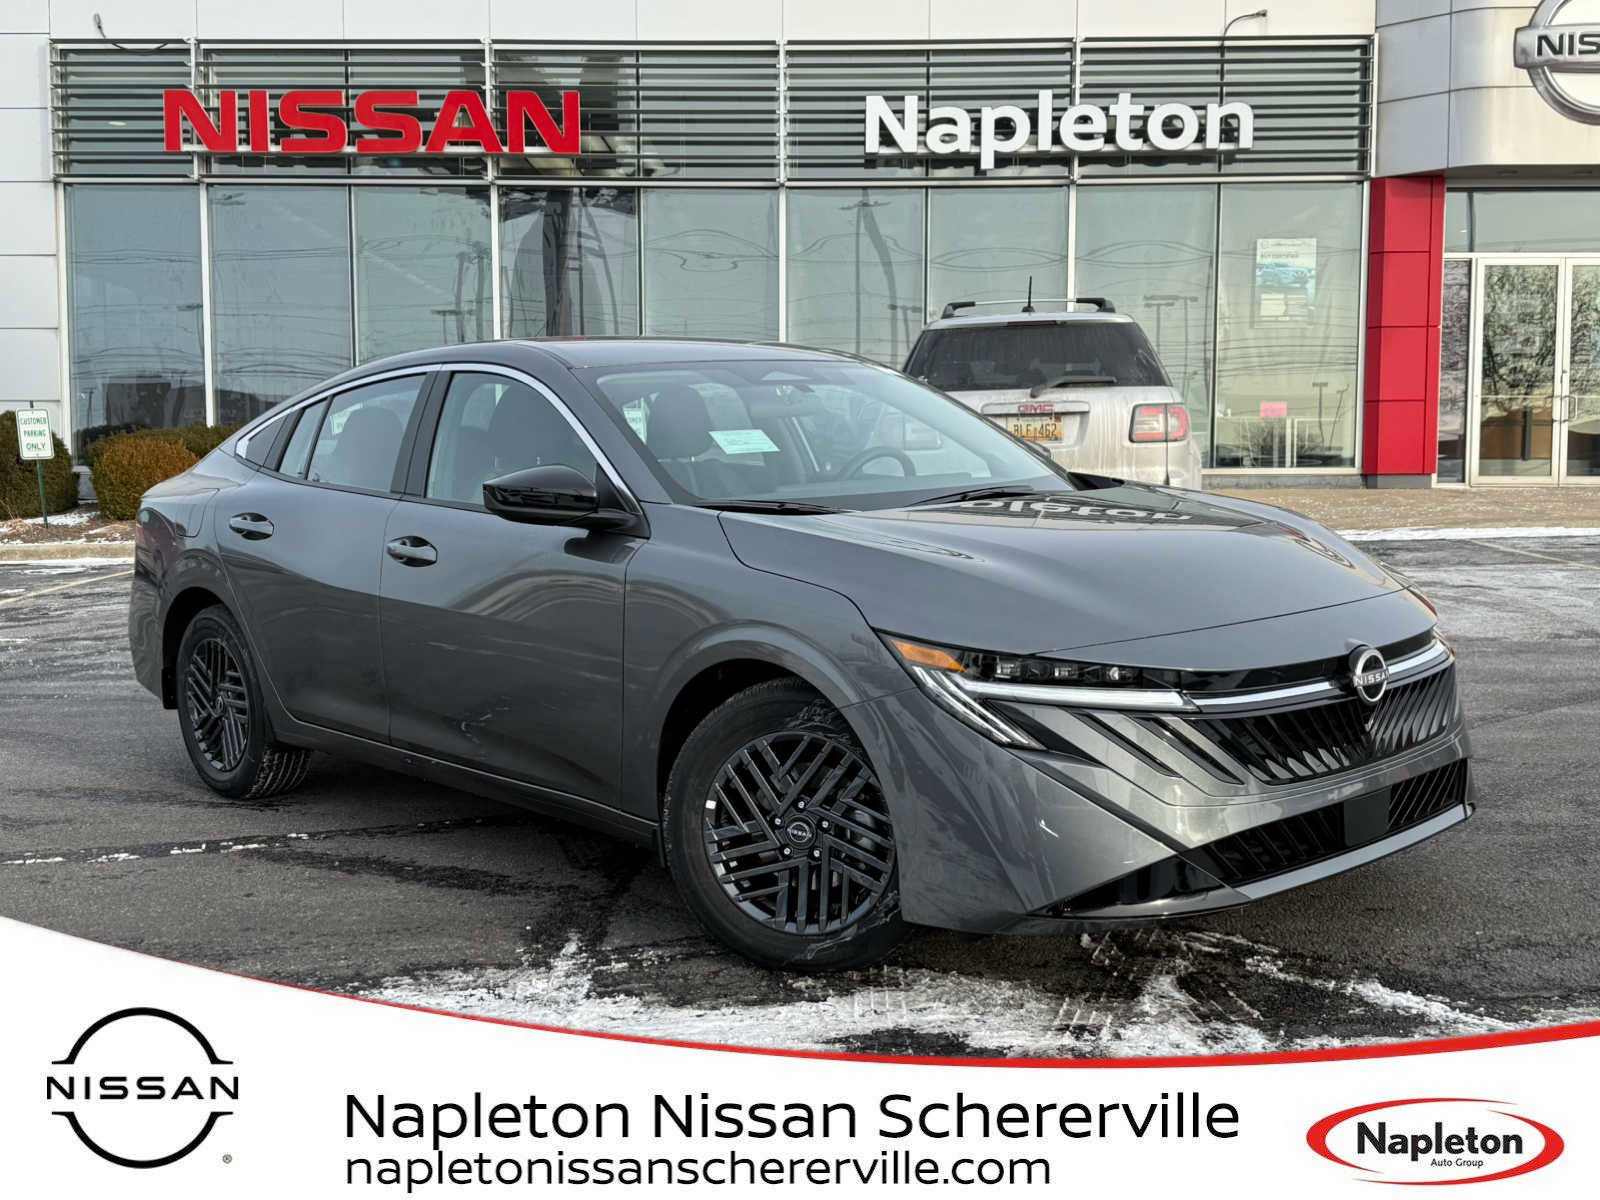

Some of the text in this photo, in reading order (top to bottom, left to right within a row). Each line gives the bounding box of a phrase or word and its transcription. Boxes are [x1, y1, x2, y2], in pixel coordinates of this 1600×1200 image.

[163, 90, 581, 154] NISSAN
[865, 89, 1254, 169] Napleton
[23, 430, 47, 438] PARKING
[1039, 423, 1057, 438] 462
[26, 442, 47, 451] ONLY
[1353, 671, 1390, 688] NISSAN
